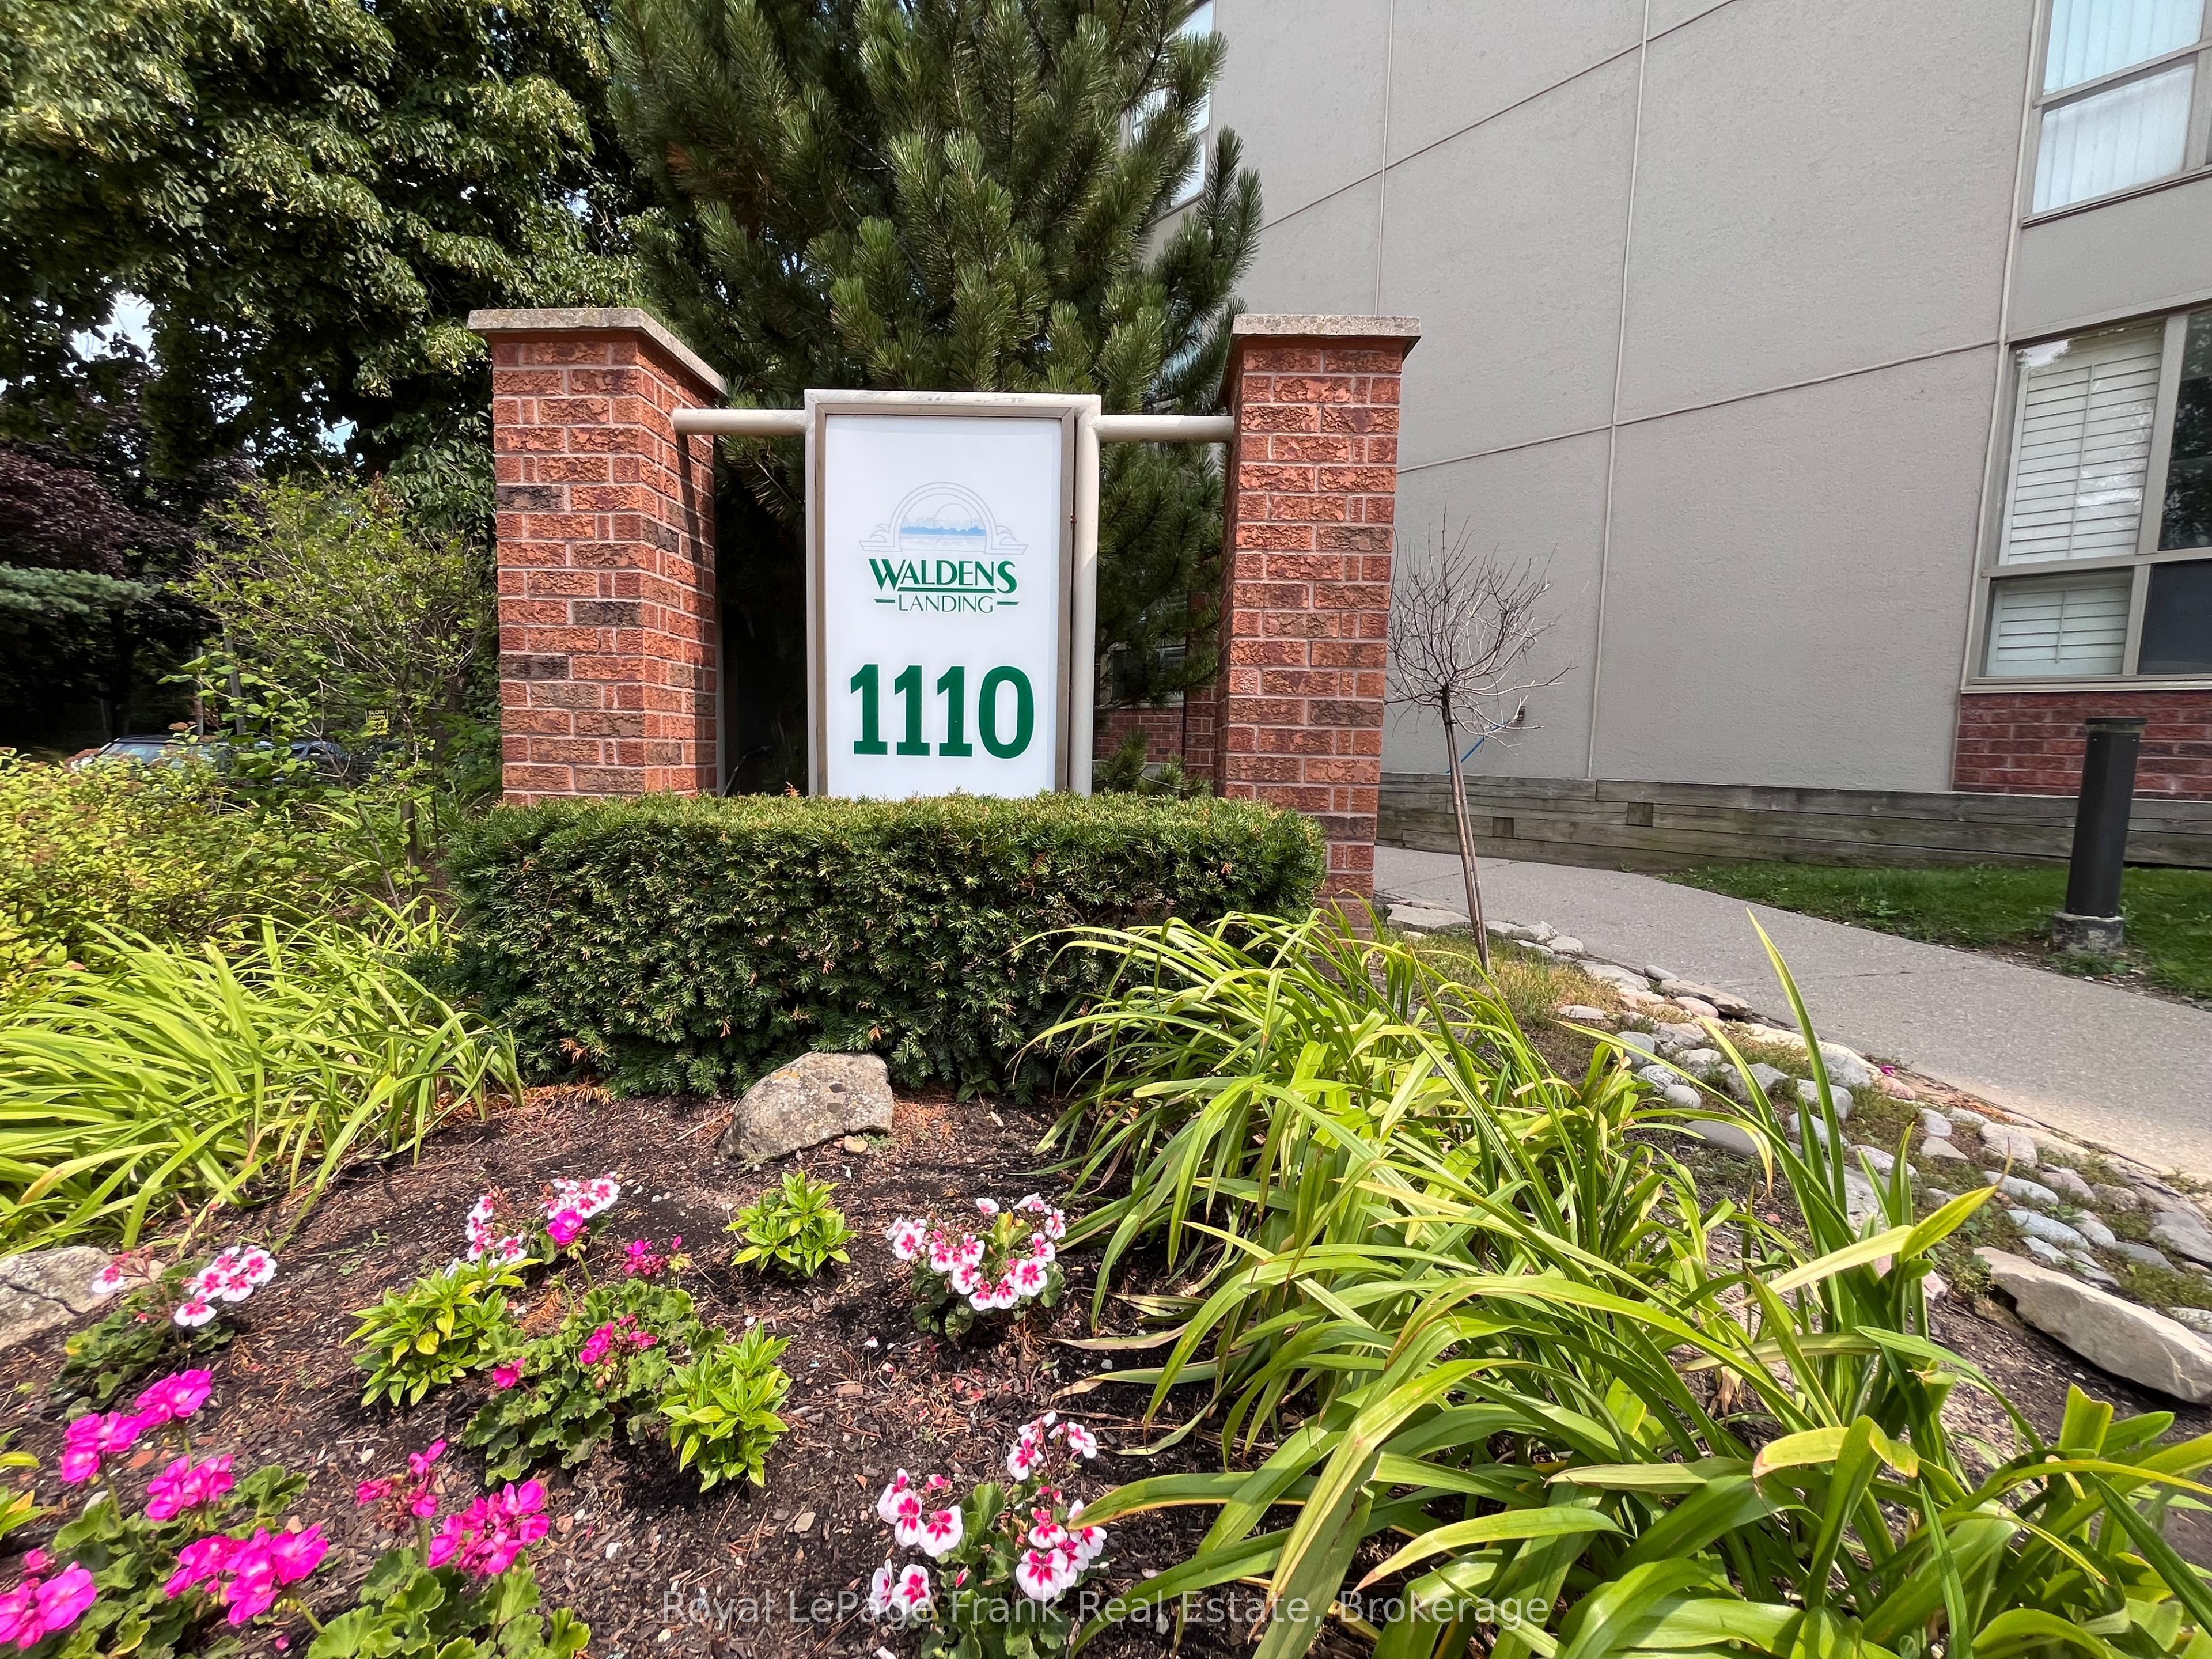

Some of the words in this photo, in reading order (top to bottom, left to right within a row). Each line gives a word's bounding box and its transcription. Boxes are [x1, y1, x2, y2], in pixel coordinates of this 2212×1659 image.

[868, 558, 1018, 594] WALDENS
[898, 594, 994, 613] LANDING
[849, 663, 1035, 760] 1110
